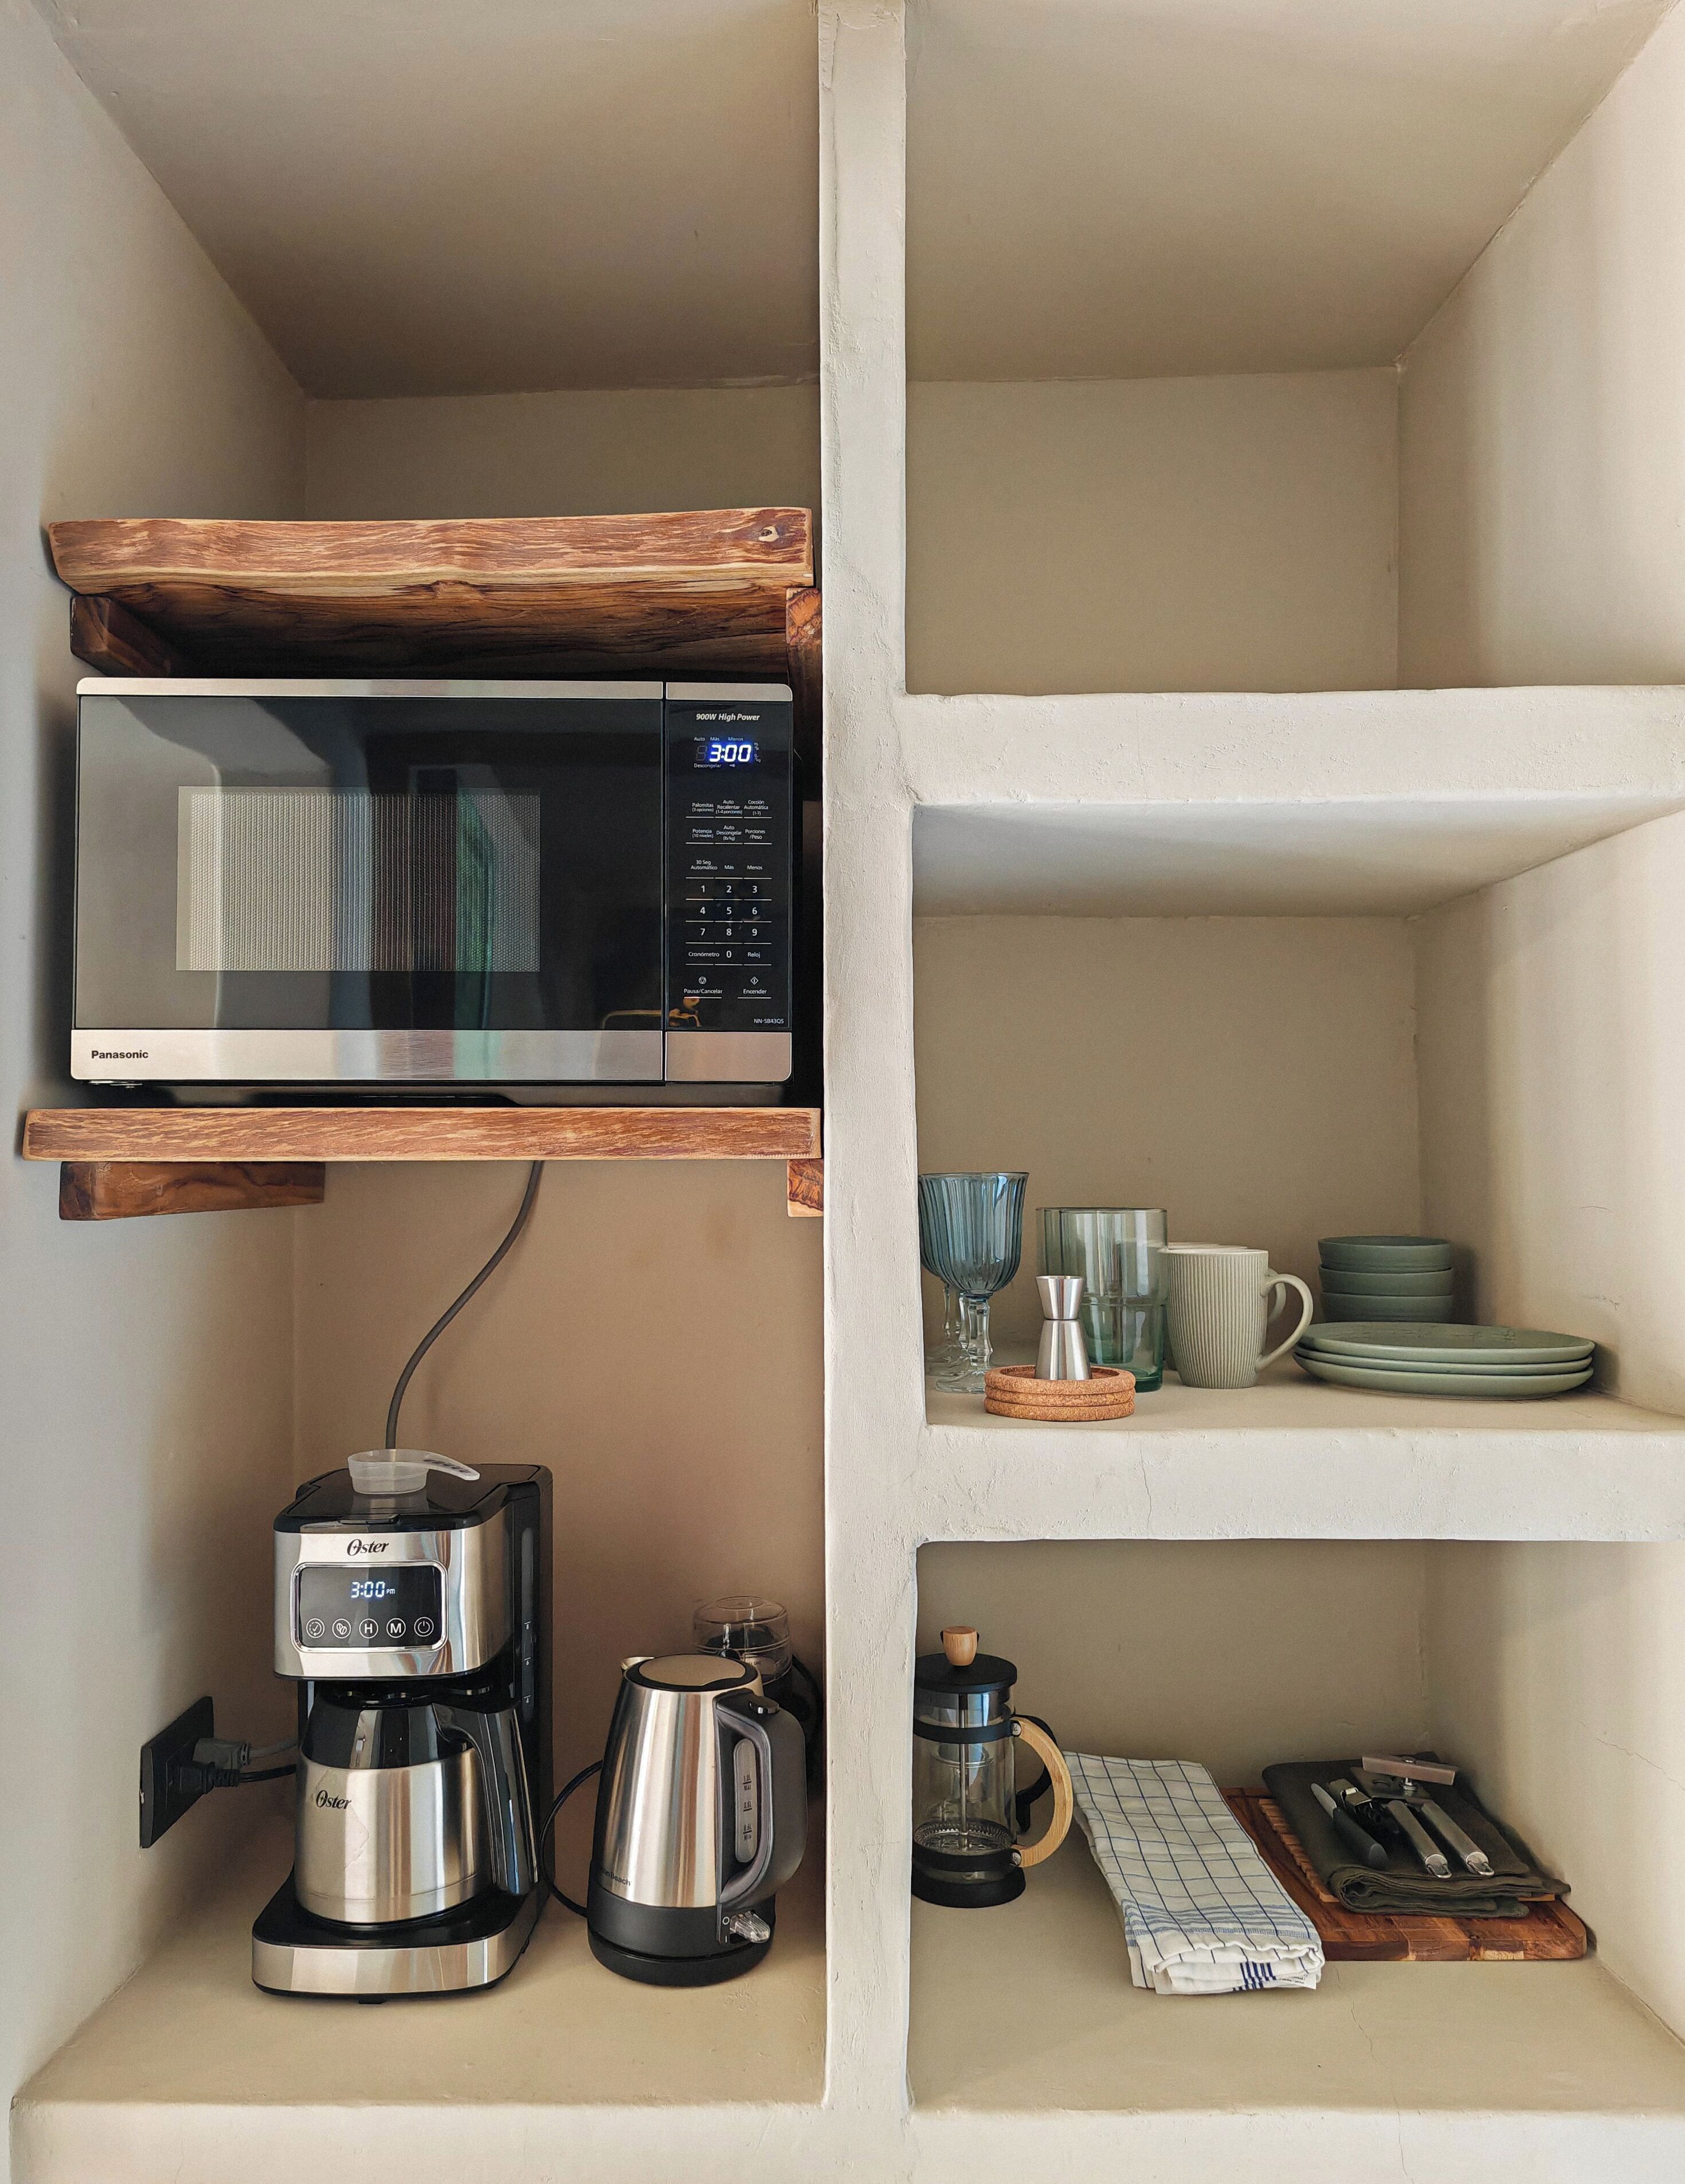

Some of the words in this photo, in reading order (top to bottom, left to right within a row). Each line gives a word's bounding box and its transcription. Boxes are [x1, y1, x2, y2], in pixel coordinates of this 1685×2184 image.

[718, 713, 736, 722] High
[709, 744, 752, 762] 3:00
[91, 1050, 149, 1059] Panasonic
[347, 1539, 389, 1556] Oster
[351, 1581, 386, 1598] 3:00
[365, 1624, 373, 1634] H
[390, 1623, 401, 1633] M
[316, 1790, 352, 1809] Oster
[611, 1872, 631, 1887] Beach
